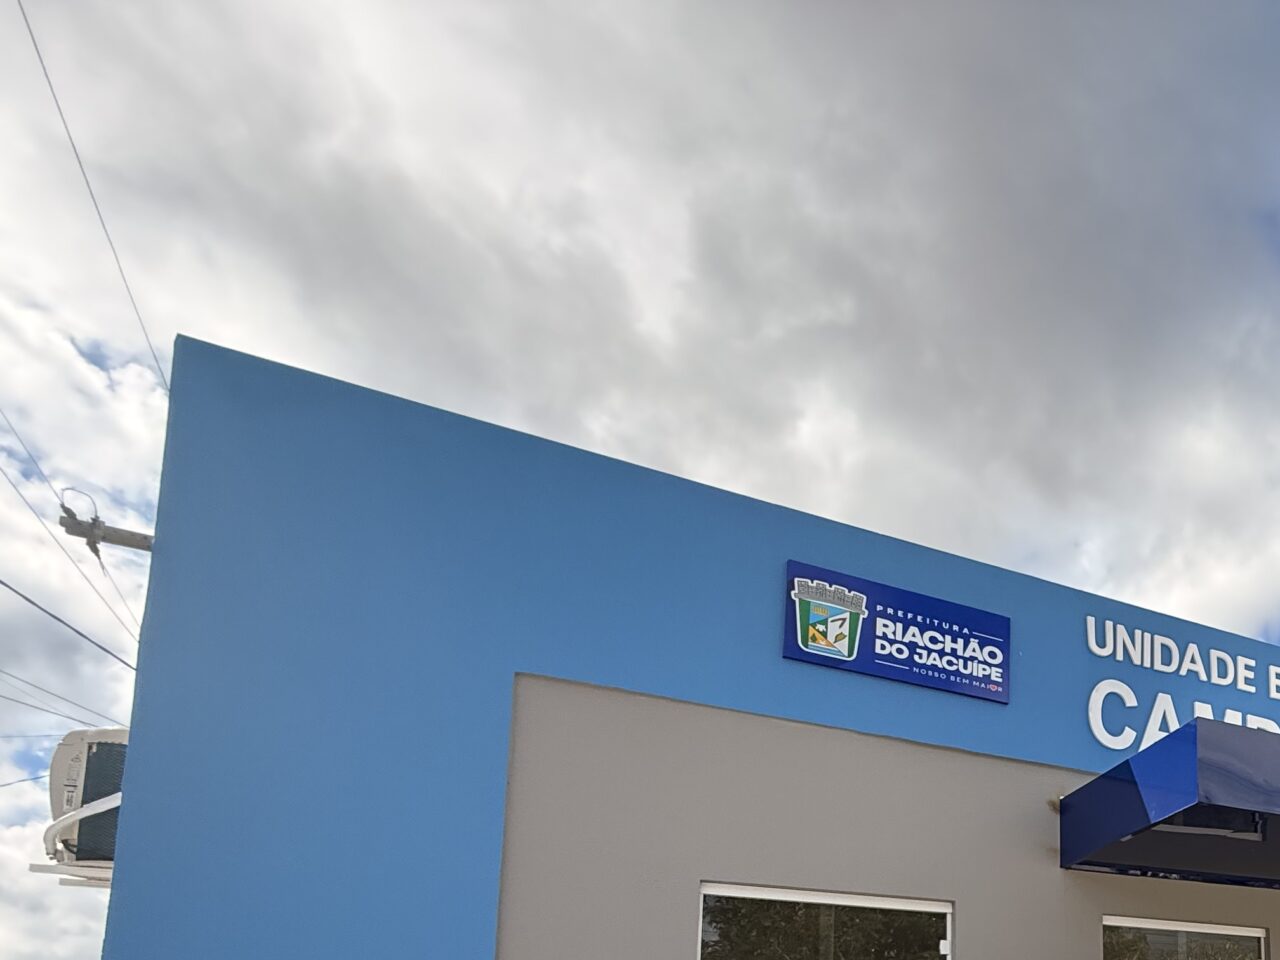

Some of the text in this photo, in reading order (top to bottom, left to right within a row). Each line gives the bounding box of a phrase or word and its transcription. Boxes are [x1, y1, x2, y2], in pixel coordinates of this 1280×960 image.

[875, 617, 1004, 665] RIACHÃO
[876, 604, 970, 635] PREFEITURA
[875, 638, 1003, 683] DO JACUÍPE
[913, 667, 947, 680] NOSSO
[950, 675, 970, 685] BEM
[1085, 615, 1256, 694] UNIDADE
